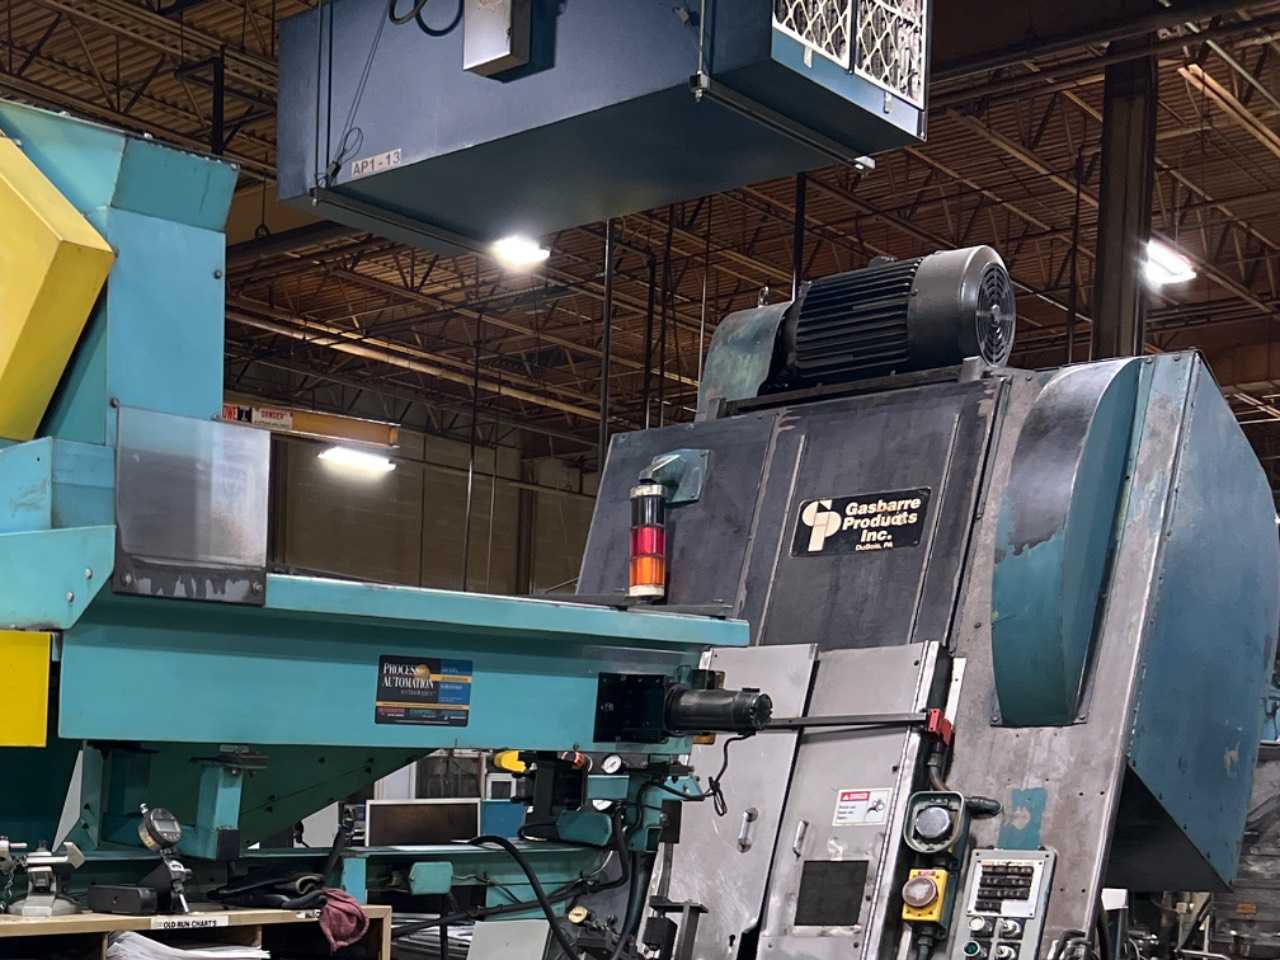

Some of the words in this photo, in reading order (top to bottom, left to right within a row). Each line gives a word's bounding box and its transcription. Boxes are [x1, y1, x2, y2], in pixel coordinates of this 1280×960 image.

[845, 498, 921, 516] Gasbarre
[842, 511, 918, 530] Products
[860, 529, 892, 542] Inc.
[383, 675, 434, 689] AUTOMATION
[191, 919, 217, 928] CHARTS
